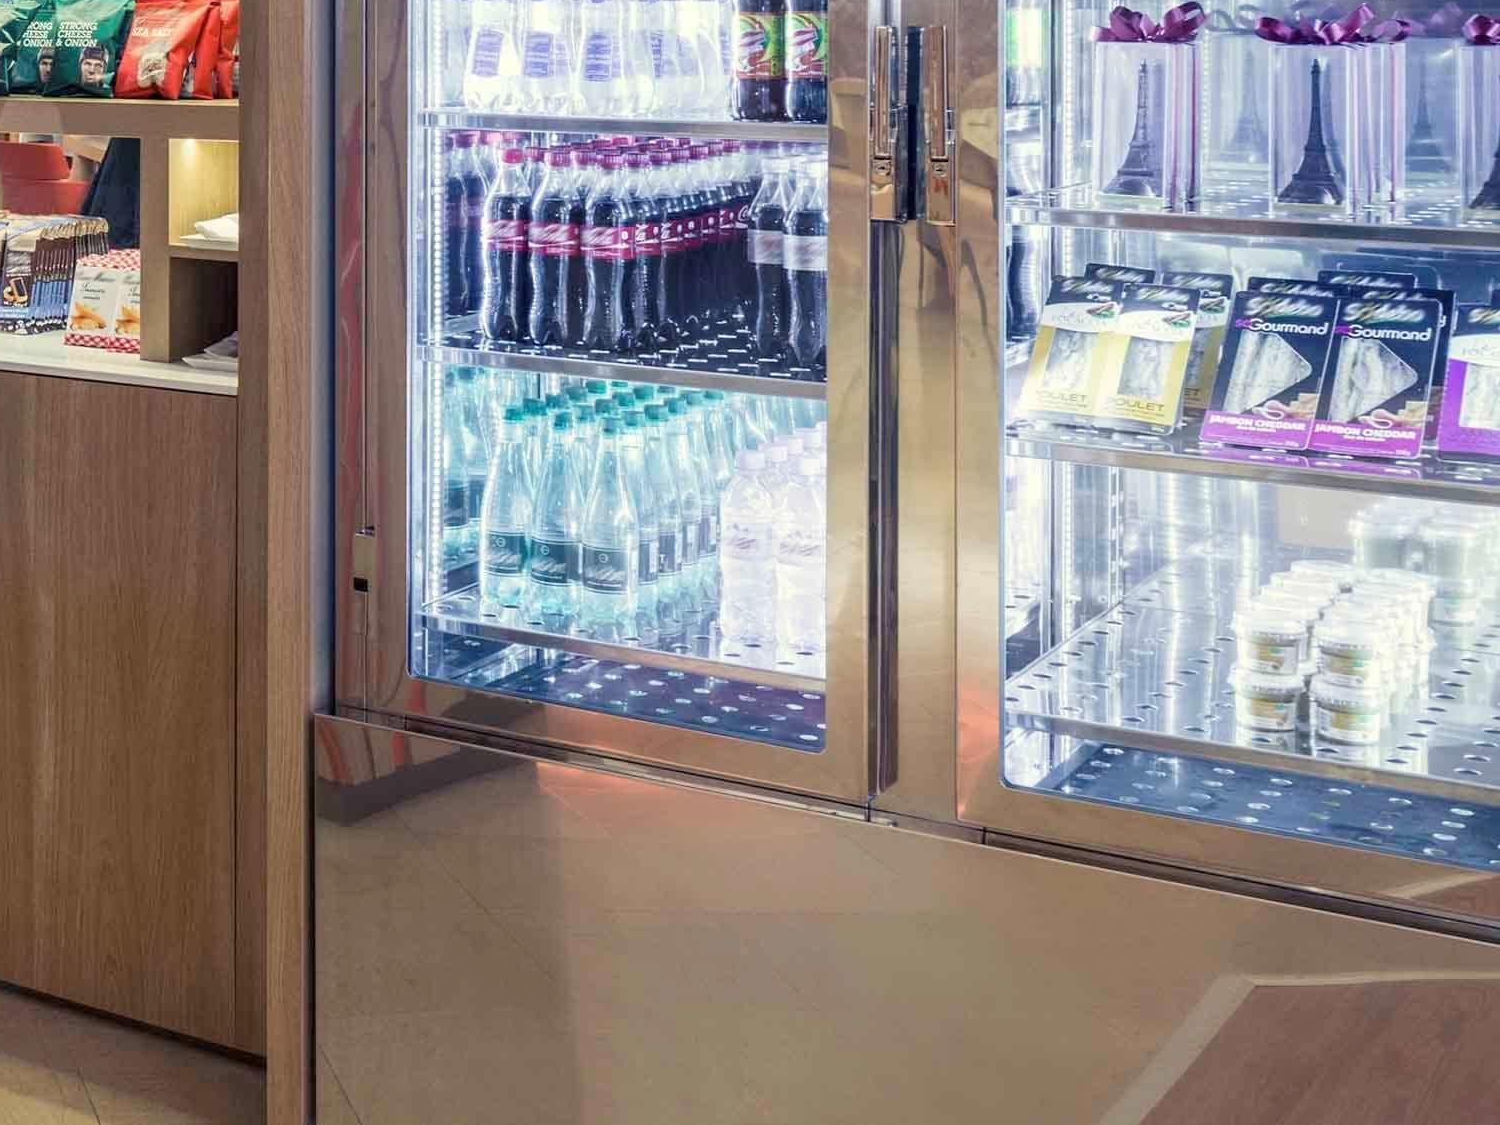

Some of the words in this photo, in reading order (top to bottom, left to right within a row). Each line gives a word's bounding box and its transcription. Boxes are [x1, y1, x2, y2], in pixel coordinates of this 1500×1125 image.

[59, 22, 98, 31] STRONG
[57, 30, 93, 39] CHEESE
[132, 27, 149, 37] SEA
[23, 39, 53, 47] ONION
[55, 39, 63, 47] &
[64, 39, 98, 48] ONION
[1209, 415, 1253, 427] JAMBON
[1254, 420, 1306, 431] CHEDDAR
[1314, 424, 1361, 436] JAMBON
[1362, 428, 1417, 440] CHEDDAR
